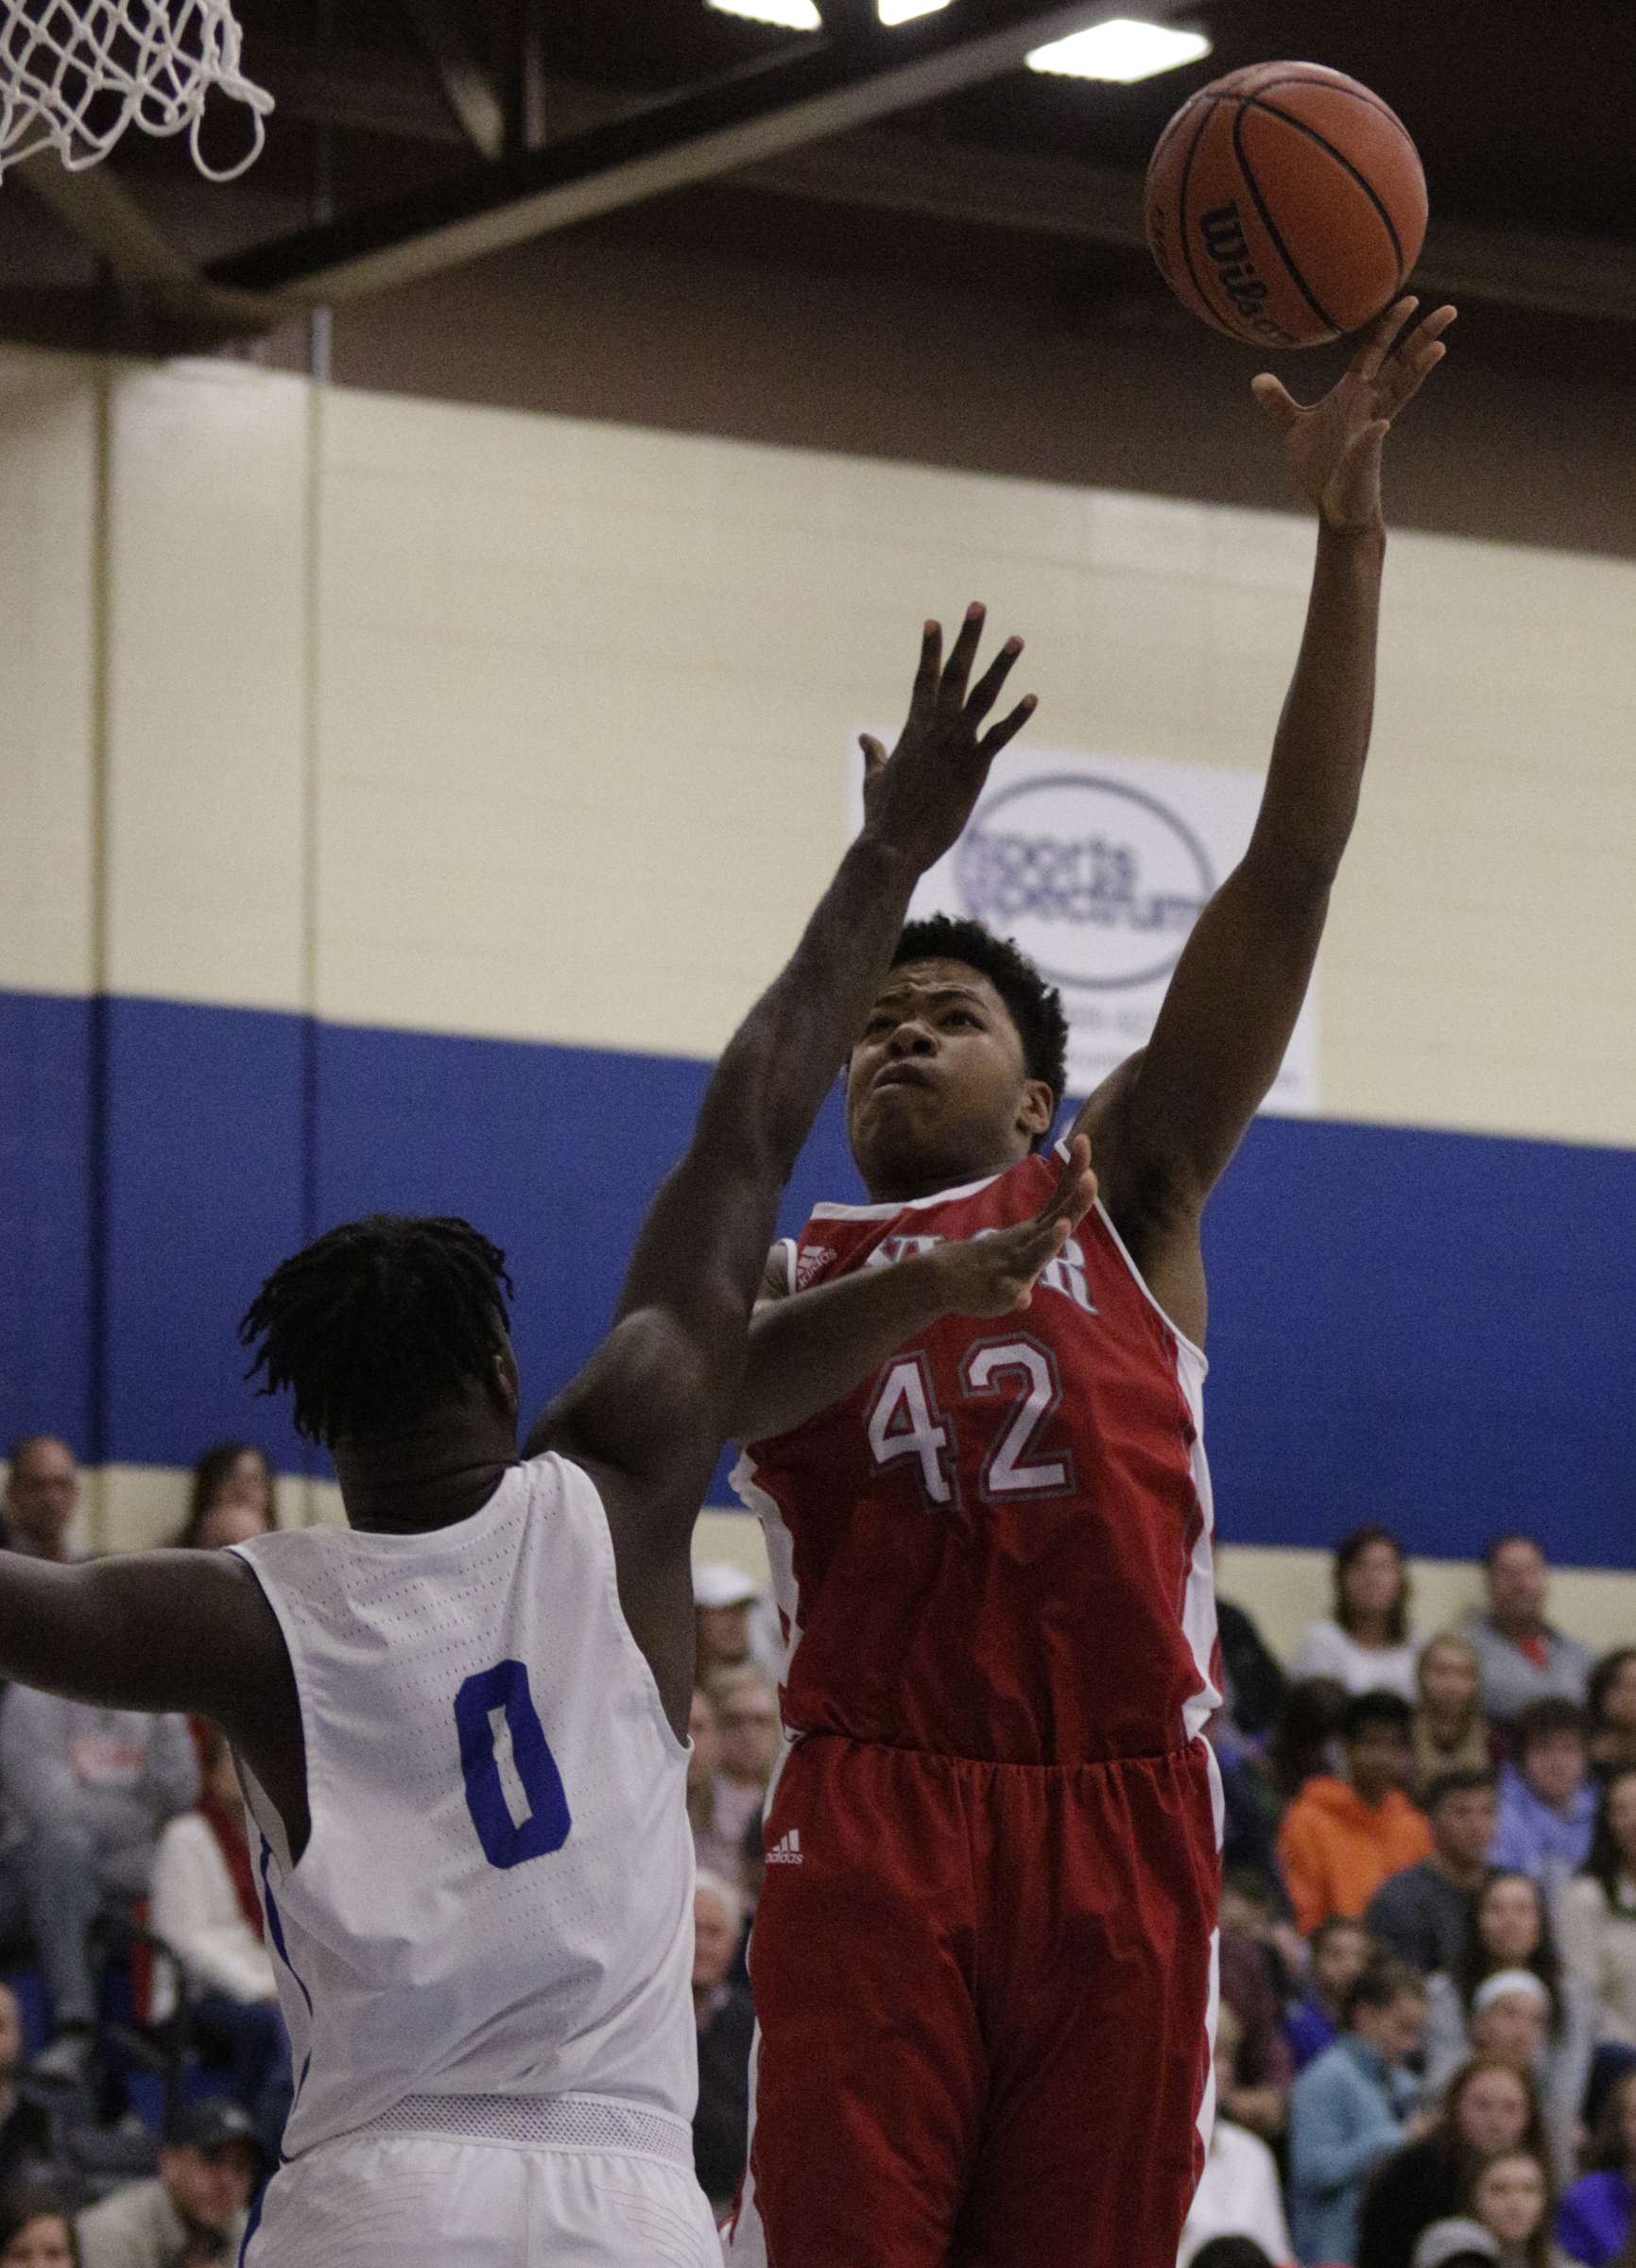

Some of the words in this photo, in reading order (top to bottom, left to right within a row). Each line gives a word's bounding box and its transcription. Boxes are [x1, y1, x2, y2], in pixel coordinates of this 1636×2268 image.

[861, 1331, 1077, 1512] 42
[453, 1658, 573, 1869] 0
[765, 1851, 804, 1865] adidas
